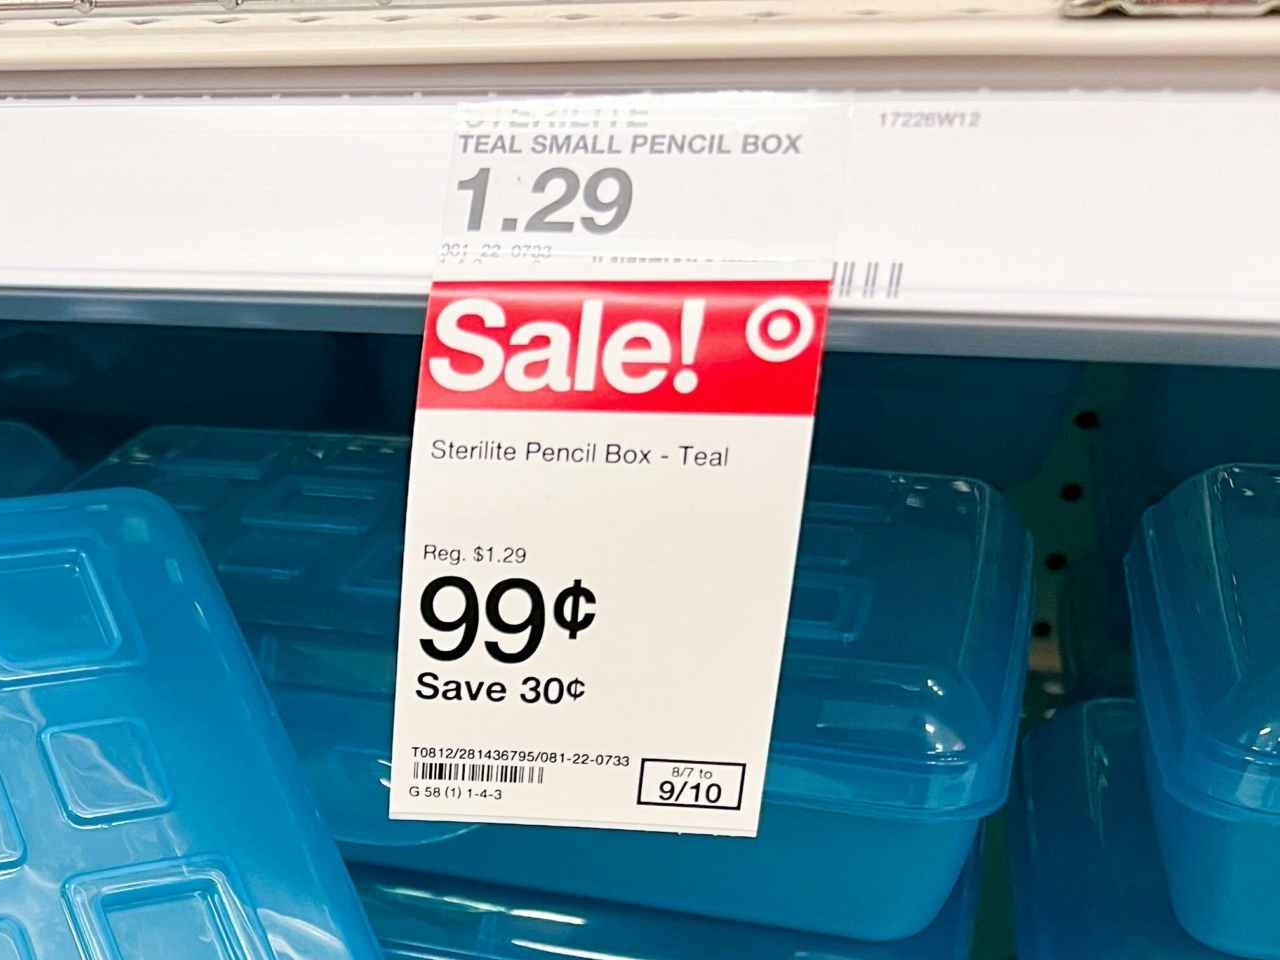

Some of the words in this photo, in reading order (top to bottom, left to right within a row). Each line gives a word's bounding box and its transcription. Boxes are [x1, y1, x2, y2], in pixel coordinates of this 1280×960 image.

[458, 133, 523, 154] TEAL
[530, 133, 622, 155] SMALL
[630, 133, 732, 155] PENCIL
[740, 134, 803, 155] BOX
[457, 166, 634, 236] 1.29
[428, 297, 705, 395] Sale!
[431, 439, 517, 462] Sterilite
[526, 441, 596, 464] Pencil
[605, 444, 651, 465] Box
[678, 445, 729, 468] Teal
[423, 544, 466, 565] Reg.
[473, 545, 526, 565] $1.29
[419, 575, 596, 664] 99¢
[416, 672, 507, 703] Save
[520, 676, 586, 704] 30¢
[411, 747, 631, 767] T0812/281436795/081-22-0733
[672, 766, 694, 778] 8/7
[699, 768, 713, 780] to
[409, 786, 420, 798] G
[424, 786, 441, 798] 58
[445, 787, 462, 800] (1)
[467, 788, 502, 800] 1-4-3
[659, 780, 722, 803] 9/10
